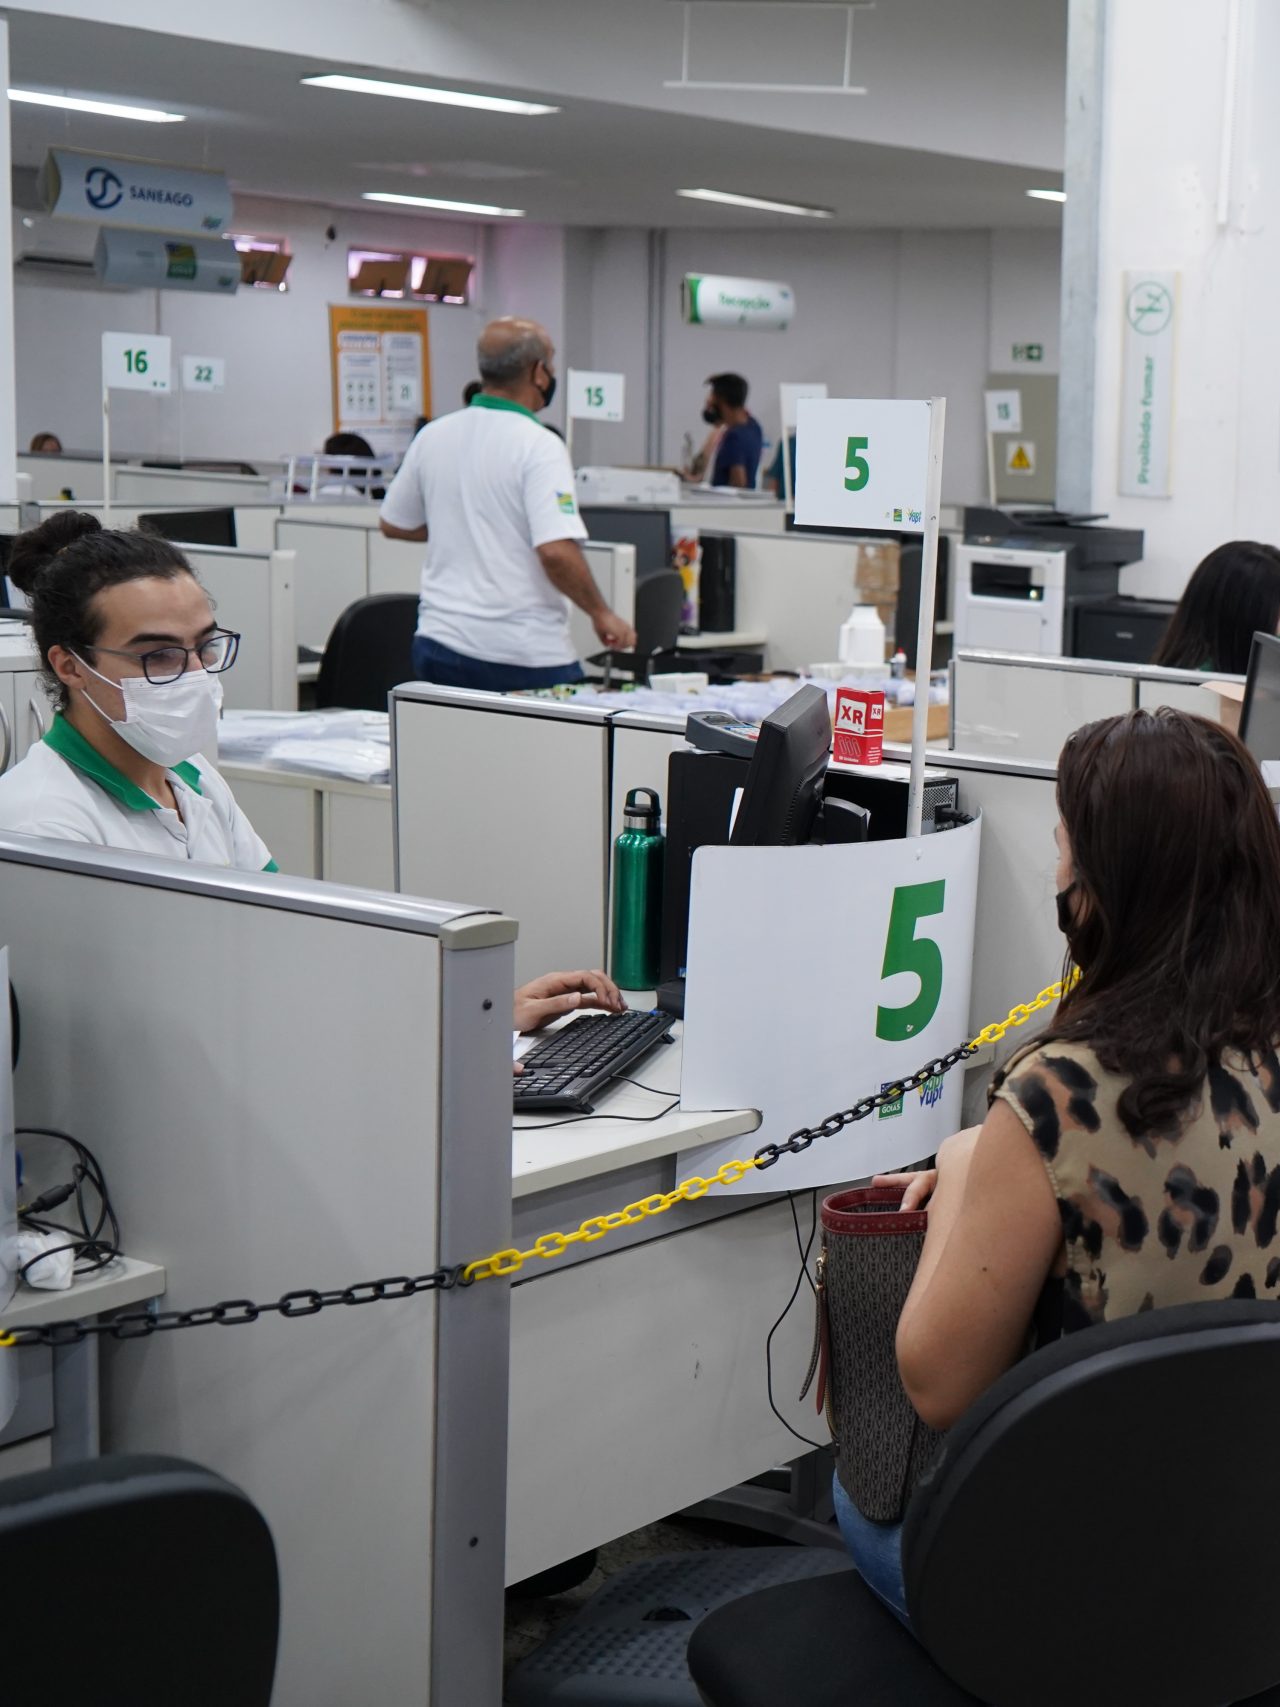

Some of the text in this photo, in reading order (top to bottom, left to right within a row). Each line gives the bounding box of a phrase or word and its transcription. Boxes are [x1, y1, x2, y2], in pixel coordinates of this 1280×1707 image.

[129, 186, 194, 207] SANEAGO
[124, 349, 148, 373] 16
[194, 366, 213, 382] 22
[585, 387, 604, 407] 15
[1137, 356, 1152, 484] Proibido fumar
[844, 437, 870, 491] 5
[841, 705, 863, 725] XR
[876, 879, 946, 1042] 5
